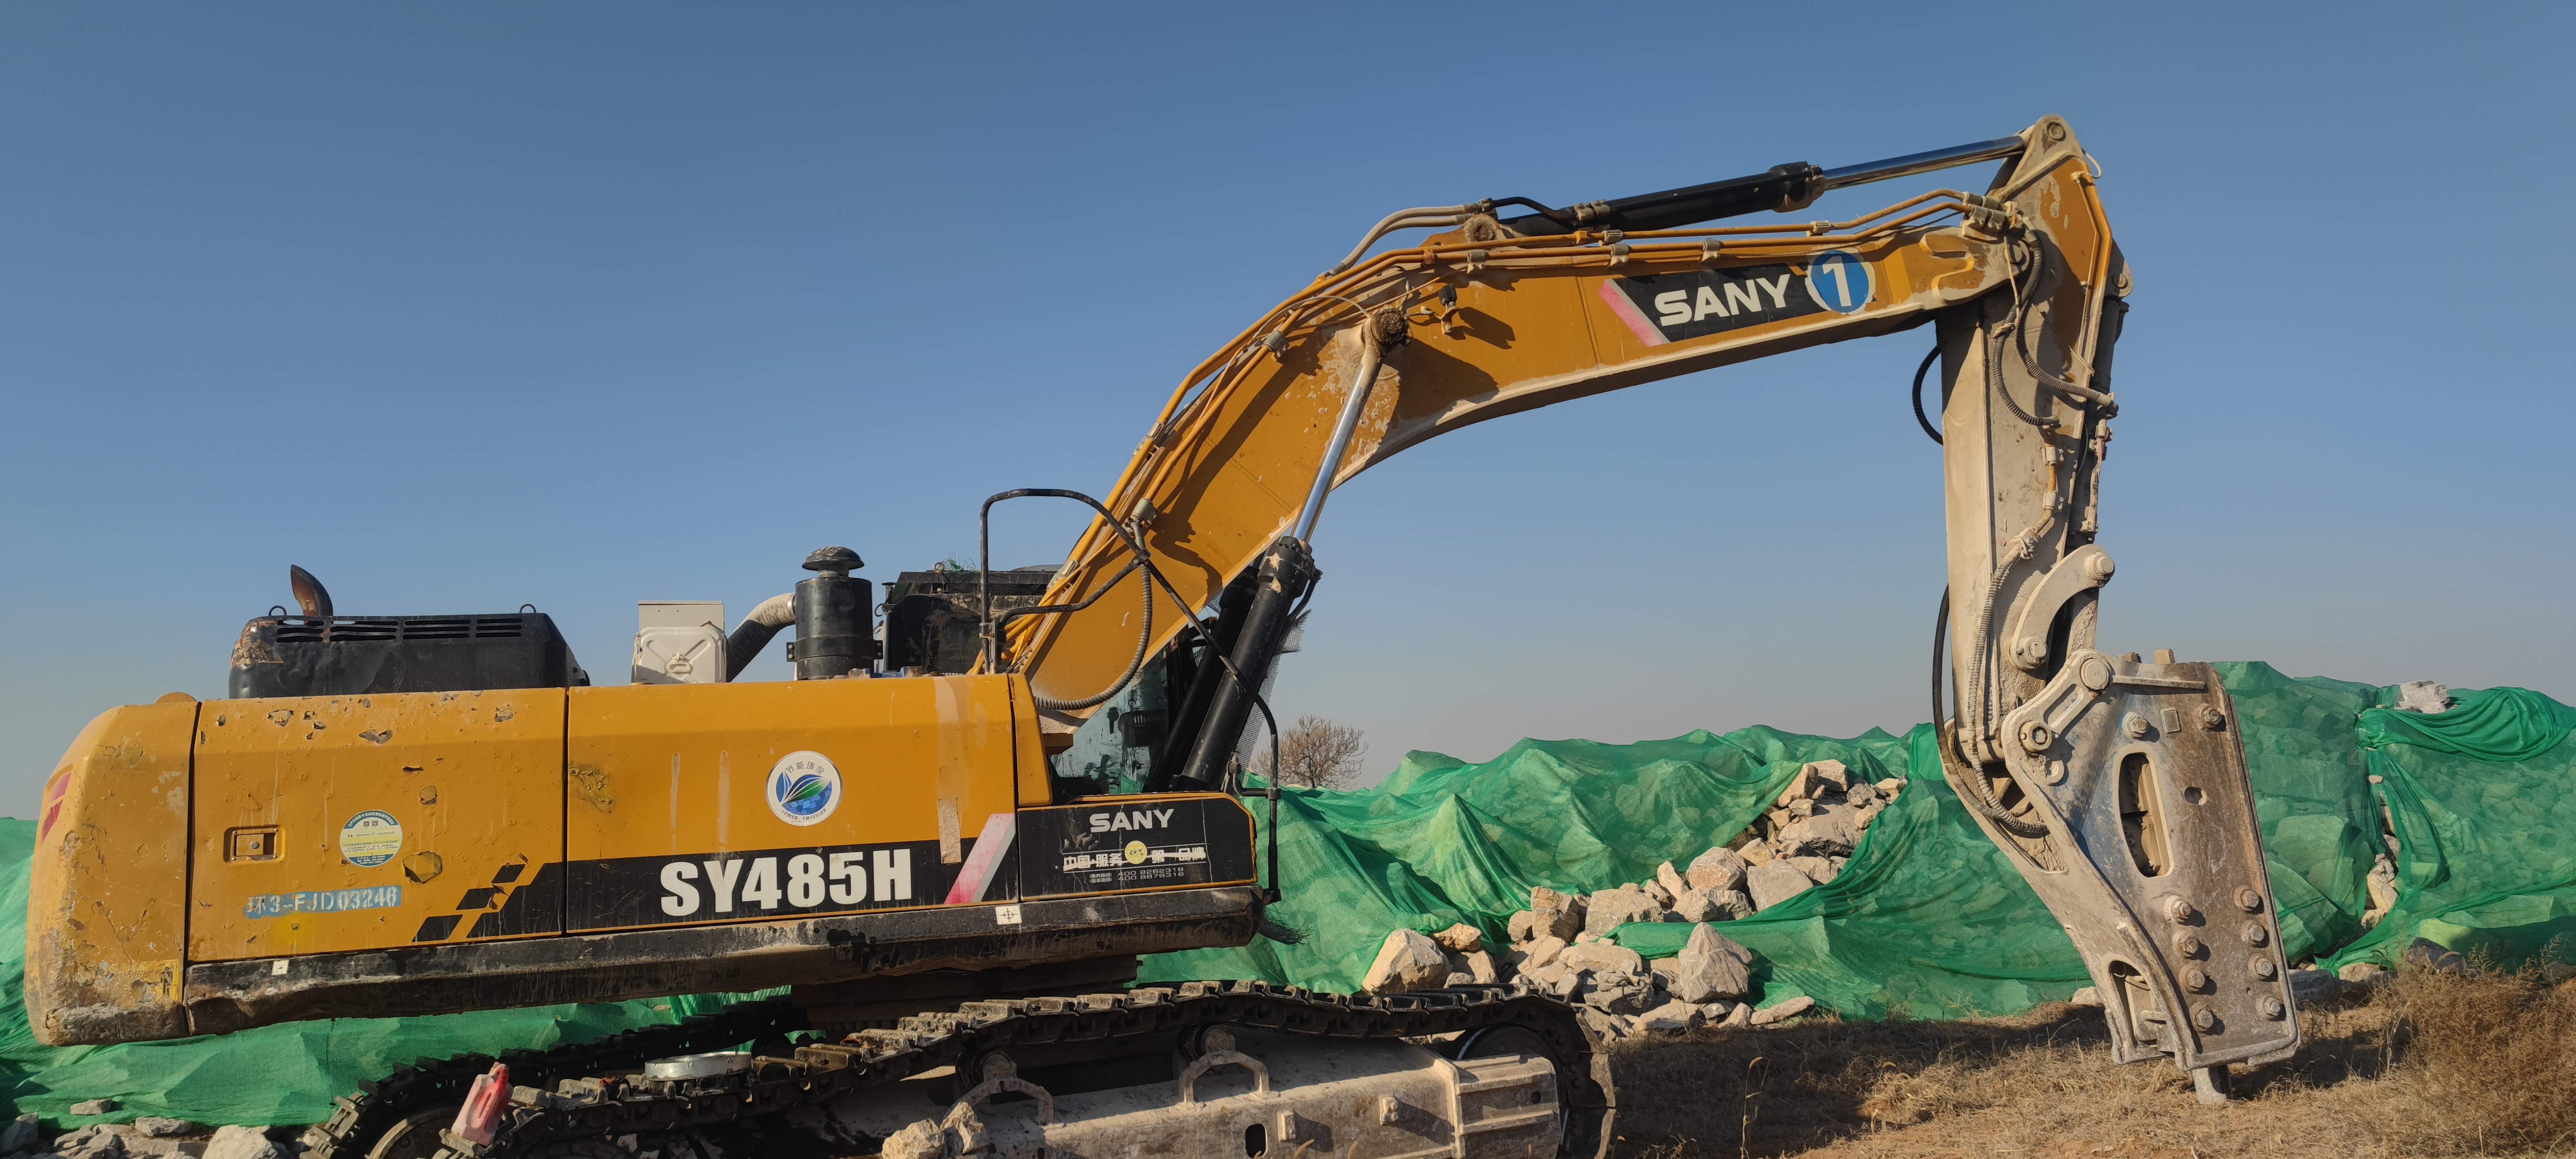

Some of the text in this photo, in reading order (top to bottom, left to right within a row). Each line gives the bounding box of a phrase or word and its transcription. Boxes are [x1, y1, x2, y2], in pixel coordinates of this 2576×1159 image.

[1654, 274, 1791, 326] SANY
[1822, 256, 1852, 307] 1
[785, 761, 825, 775] 节能环保
[781, 808, 827, 821] LOWER EMISSION
[1089, 809, 1174, 833] SANY
[660, 848, 912, 916] SY485H
